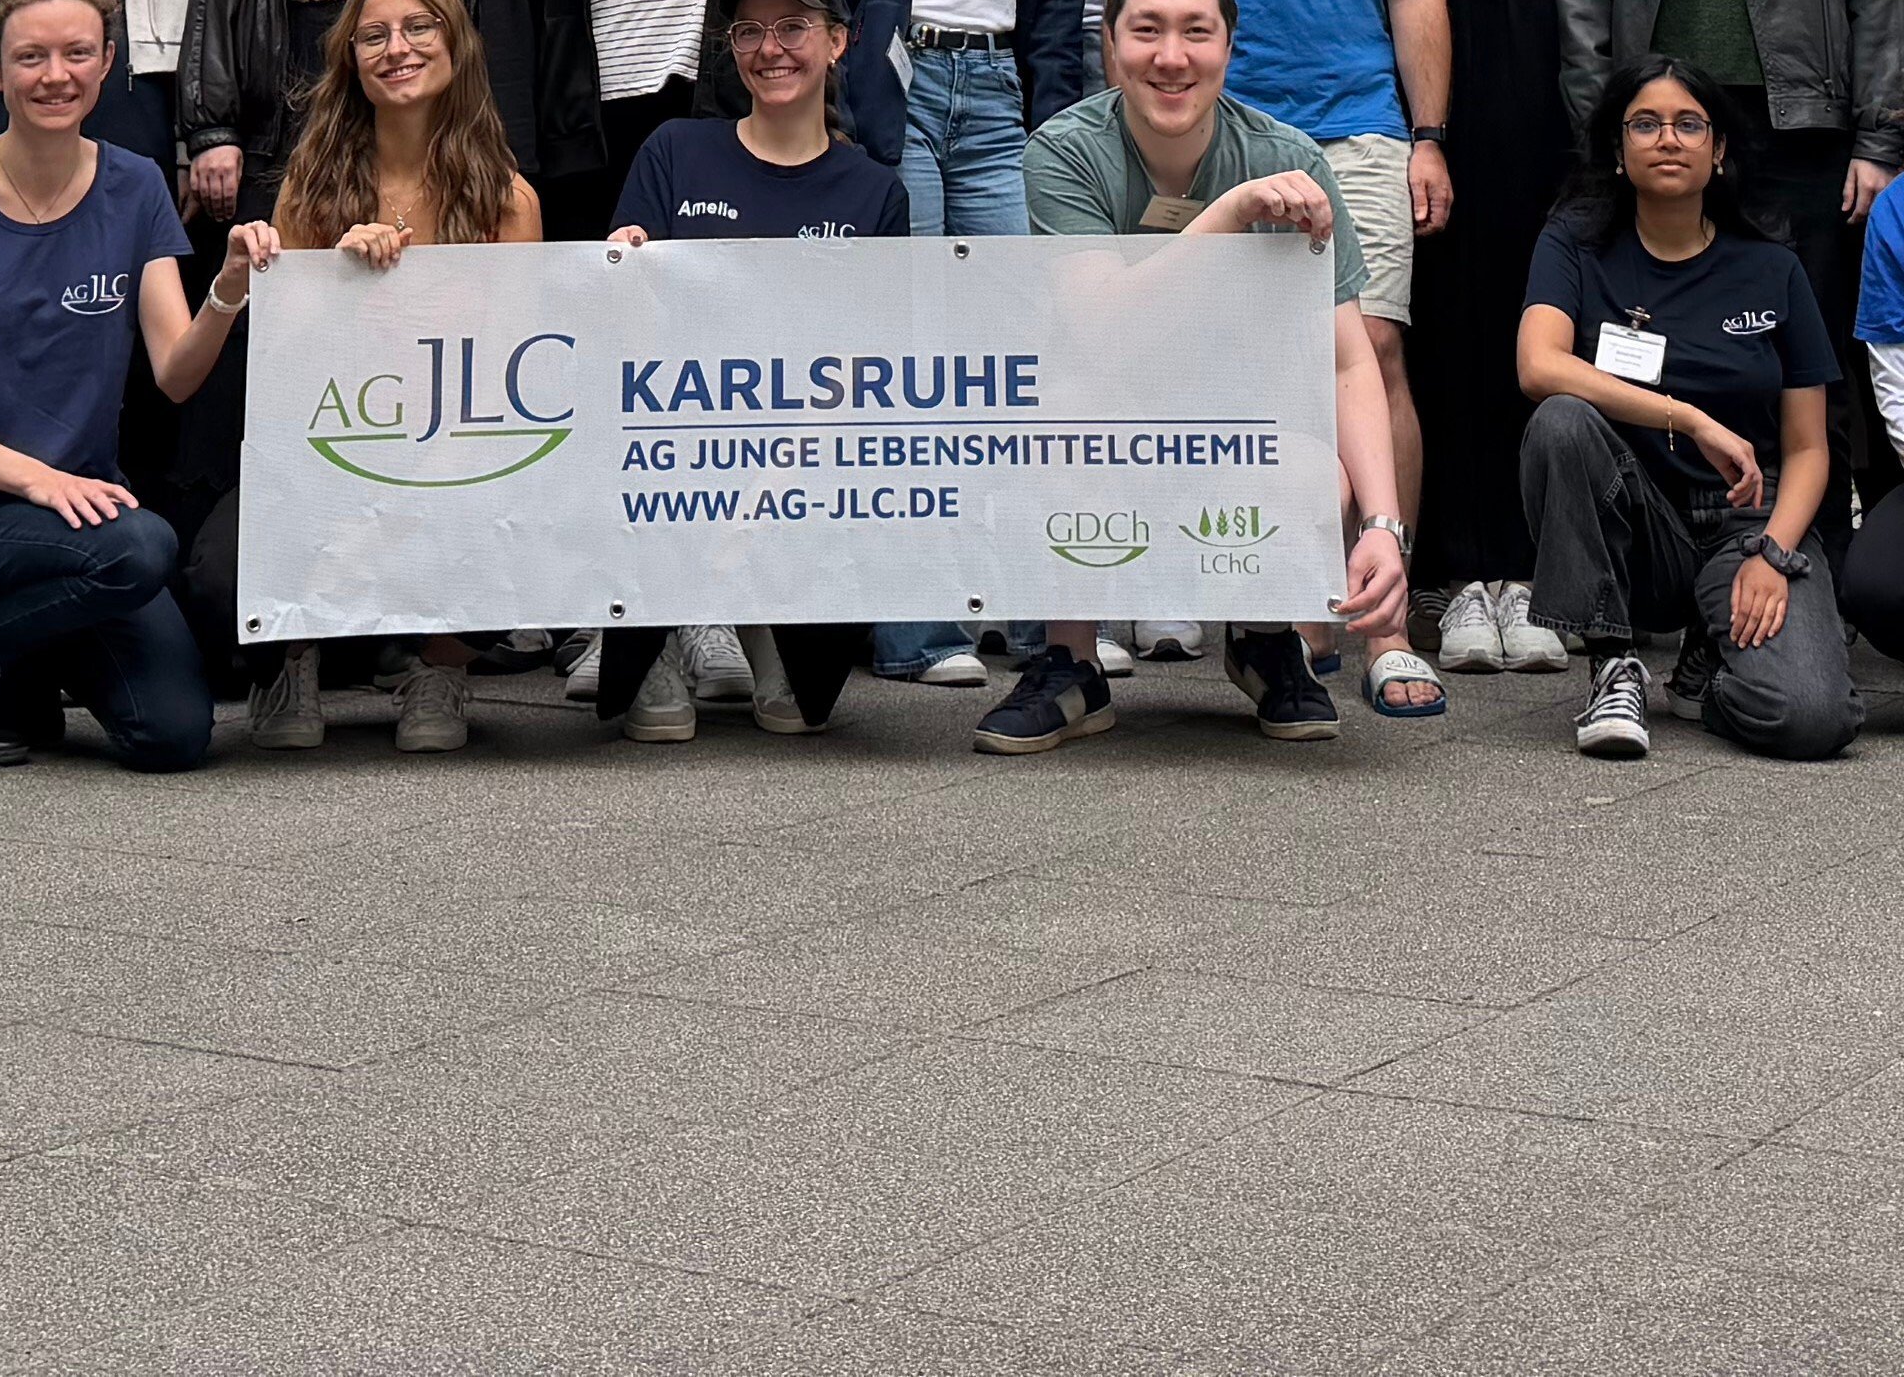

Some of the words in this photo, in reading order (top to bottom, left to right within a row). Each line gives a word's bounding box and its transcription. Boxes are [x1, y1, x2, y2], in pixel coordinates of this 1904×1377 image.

[677, 200, 739, 220] Amelie
[621, 355, 1040, 412] KARLSRUHE
[621, 440, 676, 471] AG
[690, 437, 820, 470] JUNGE
[835, 434, 1280, 467] LEBENSMITTELCHEMIE
[621, 486, 960, 523] WWW.AG-JLC.DE
[1045, 510, 1150, 543] GDCh
[1200, 553, 1261, 574] LChG
